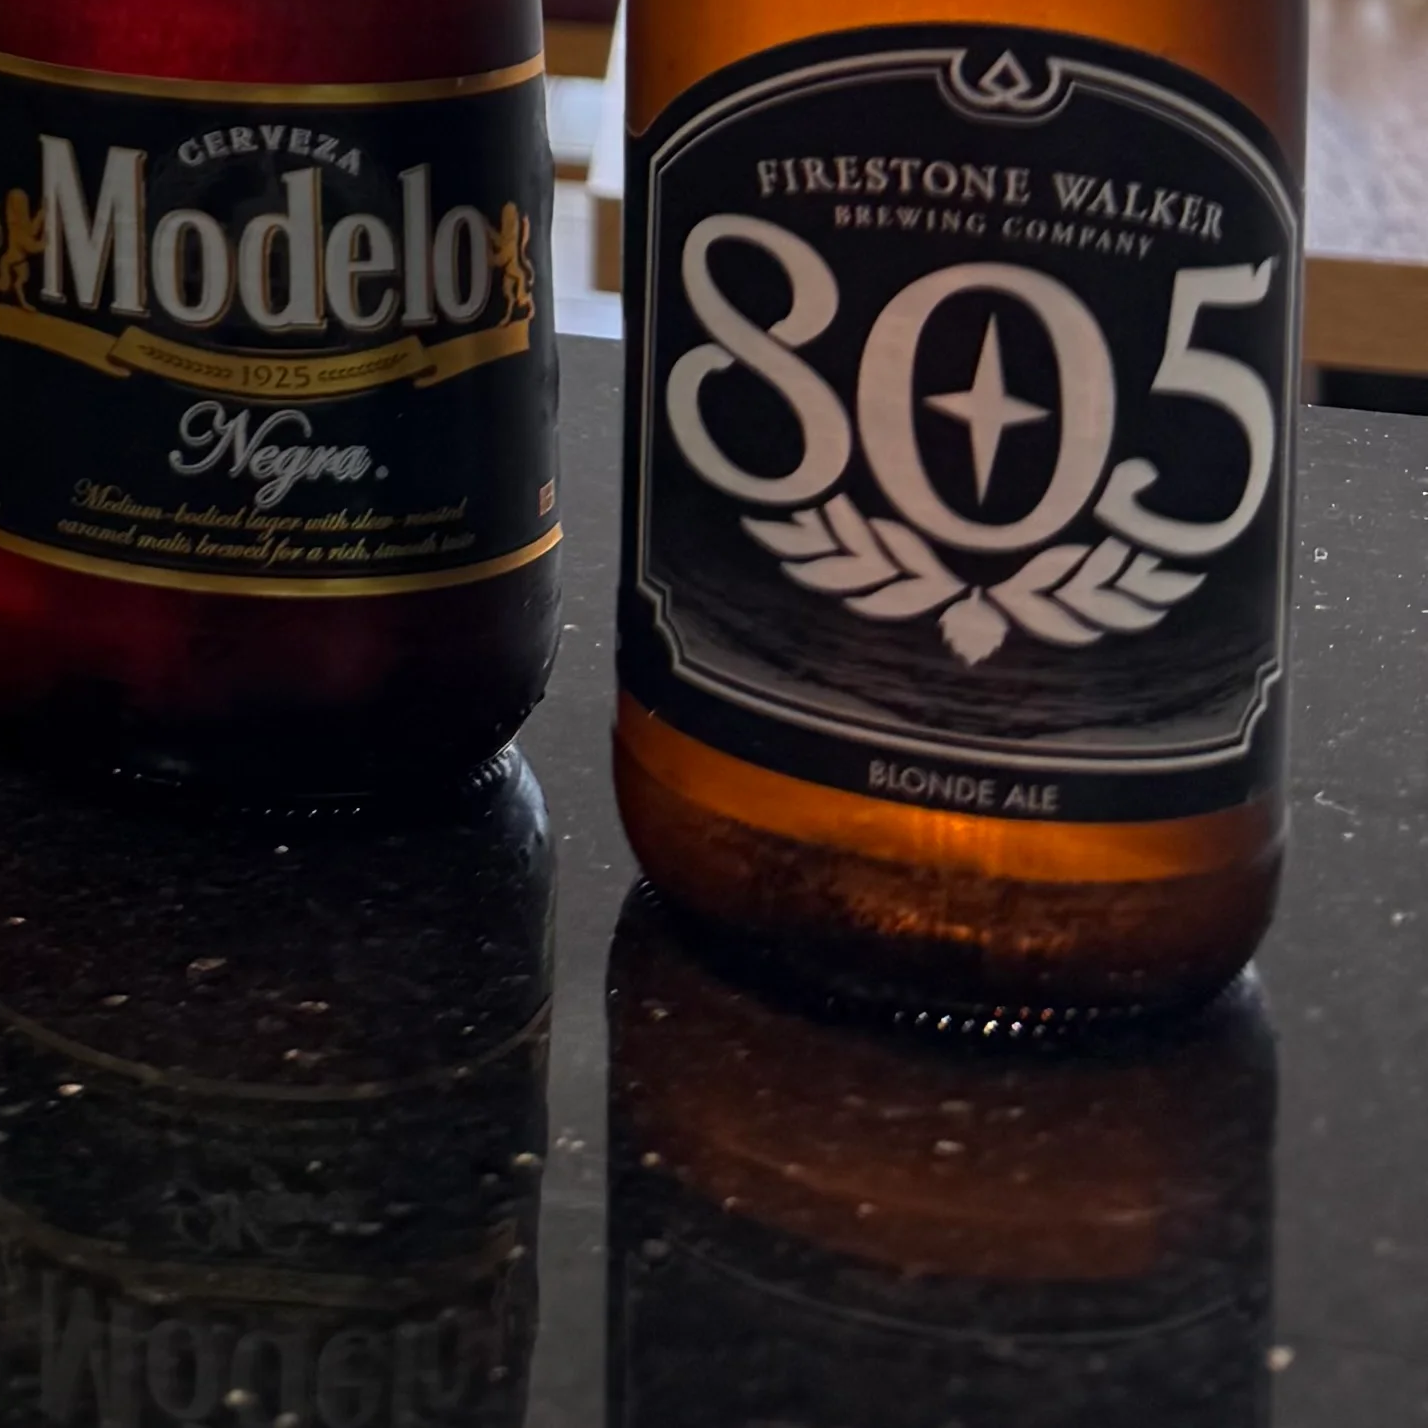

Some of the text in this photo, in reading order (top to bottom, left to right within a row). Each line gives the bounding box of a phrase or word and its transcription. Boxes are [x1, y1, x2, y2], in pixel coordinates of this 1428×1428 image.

[177, 124, 362, 176] CERVEZA
[756, 154, 1225, 240] FIRESTONE WALKER
[38, 133, 492, 335] Modelo
[833, 204, 1156, 262] BREWING COMPANY
[242, 363, 312, 389] 1925
[666, 212, 1280, 560] 805
[70, 477, 245, 530] Medium-bodied
[867, 758, 1061, 812] BLONDE ALE
